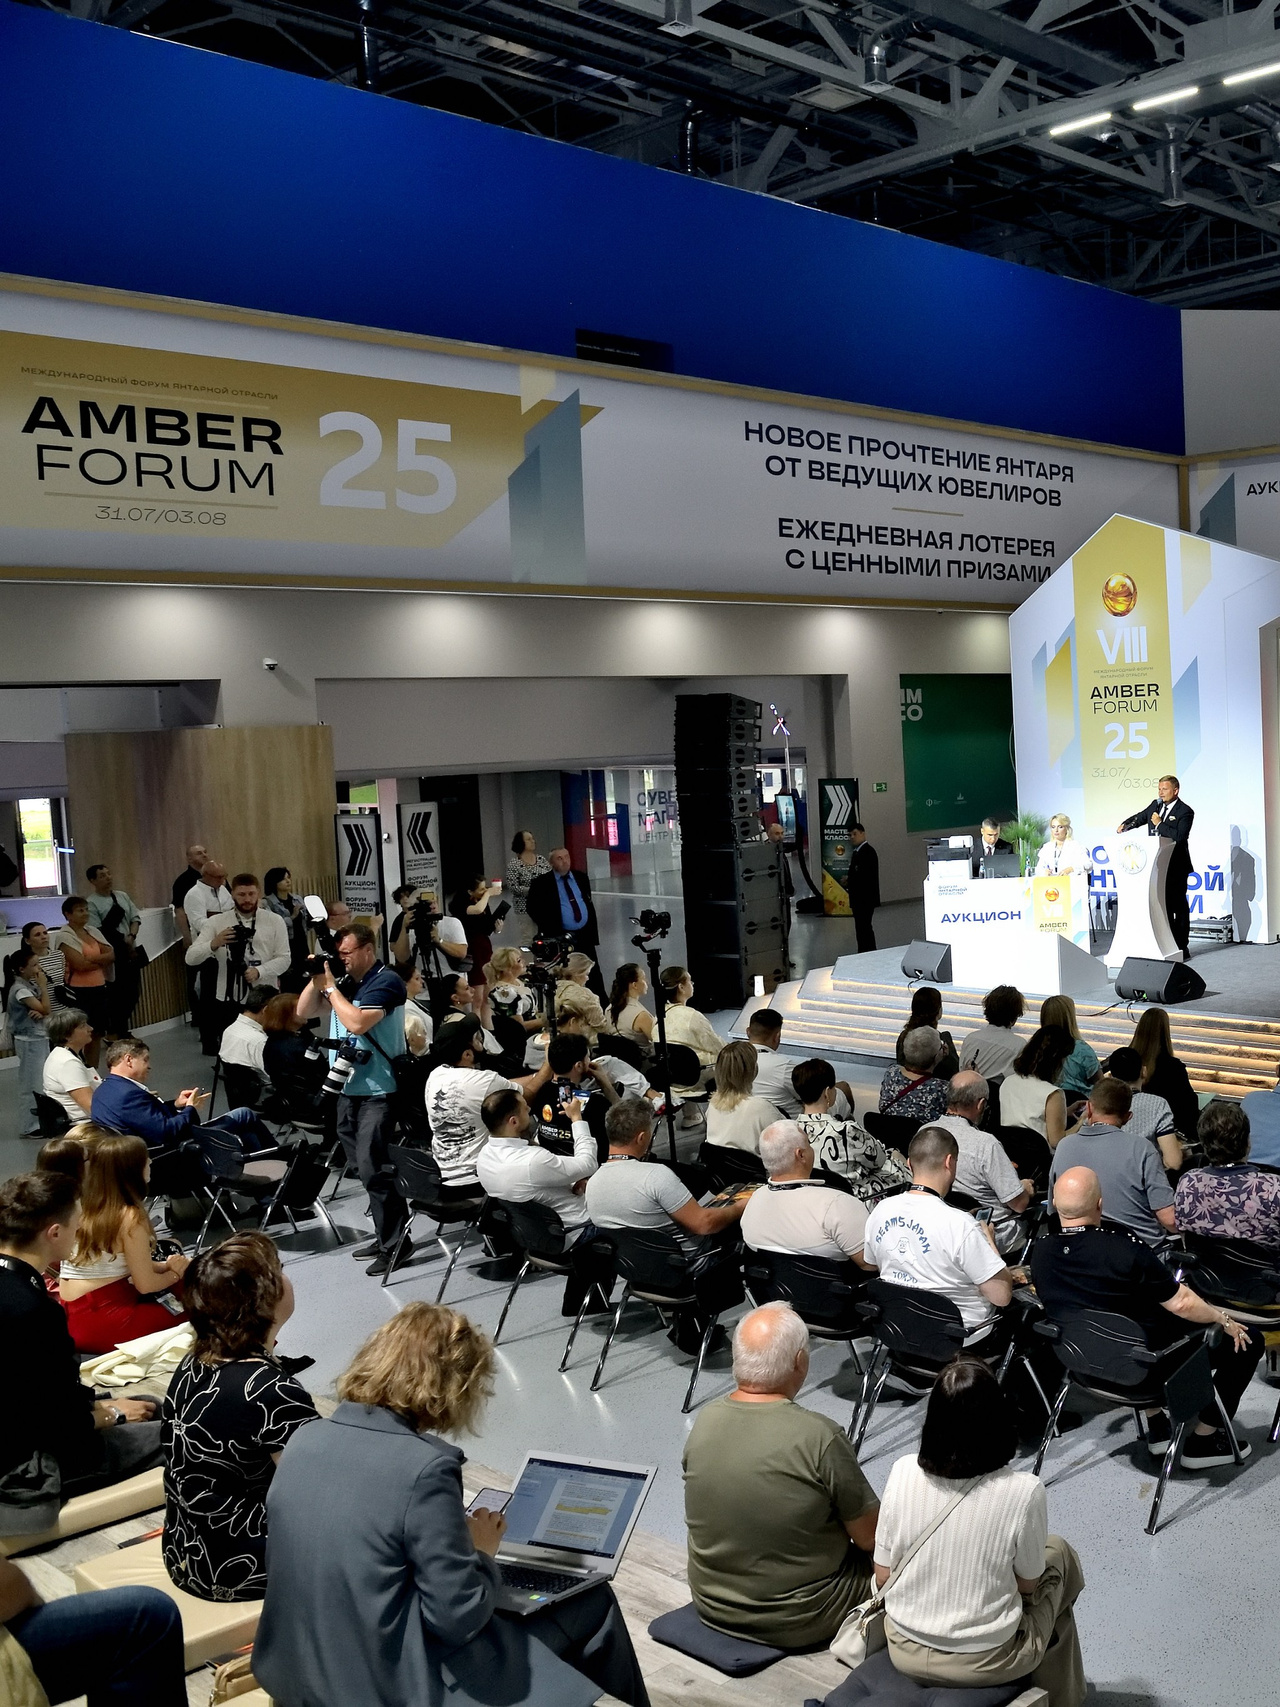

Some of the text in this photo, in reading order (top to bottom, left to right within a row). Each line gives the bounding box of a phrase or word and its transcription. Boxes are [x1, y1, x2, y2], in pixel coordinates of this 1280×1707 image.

[21, 366, 279, 400] МЕЖДУНАРОДНЫЙ ФОРУМ ЯНТАРНОЙ ОТРАСЛИ
[21, 396, 284, 455] AMBER
[36, 444, 275, 496] FORUM
[318, 411, 458, 514] 25
[744, 420, 1074, 484] НОВОЕ ПРОЧТЕНИЕ ЯНТАРЯ
[765, 455, 1063, 507] ОТ ВЕДУЩИХ ЮВЕЛИРОВ
[95, 505, 227, 526] 31.07/03.08
[778, 517, 1056, 558] ЕЖЕДНЕВНАЯ ЛОТЕРЕЯ
[784, 549, 1052, 583] С ЦЕННЫМИ ПРИЗАМИ
[1096, 626, 1149, 665] VIII
[1090, 683, 1160, 700] AMBER
[1093, 699, 1158, 714] FORUM
[1104, 722, 1150, 760] 25
[1091, 767, 1131, 779] 31.07/
[941, 910, 1022, 924] АУКЦИОН
[558, 1129, 571, 1139] 25
[876, 1216, 931, 1254] BEAMS JAPAN
